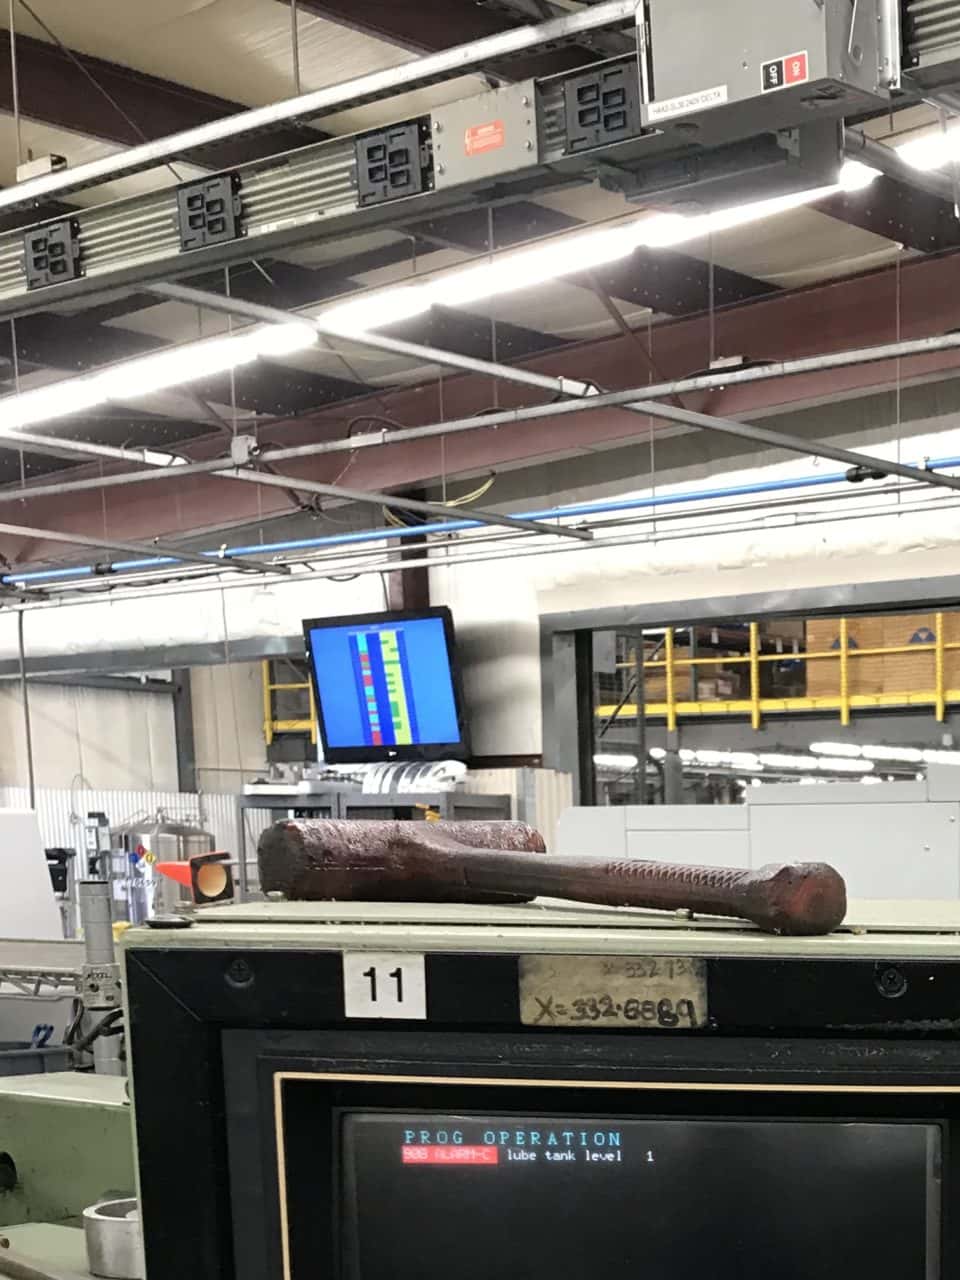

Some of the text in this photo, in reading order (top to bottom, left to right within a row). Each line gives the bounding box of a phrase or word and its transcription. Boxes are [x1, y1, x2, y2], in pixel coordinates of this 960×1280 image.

[769, 65, 778, 85] OFF
[791, 61, 800, 76] ON
[362, 967, 403, 1002] 11
[404, 1130, 622, 1146] PROG OPERATION
[507, 1149, 537, 1161] lube
[545, 1150, 576, 1161] tank
[585, 1150, 622, 1161] level
